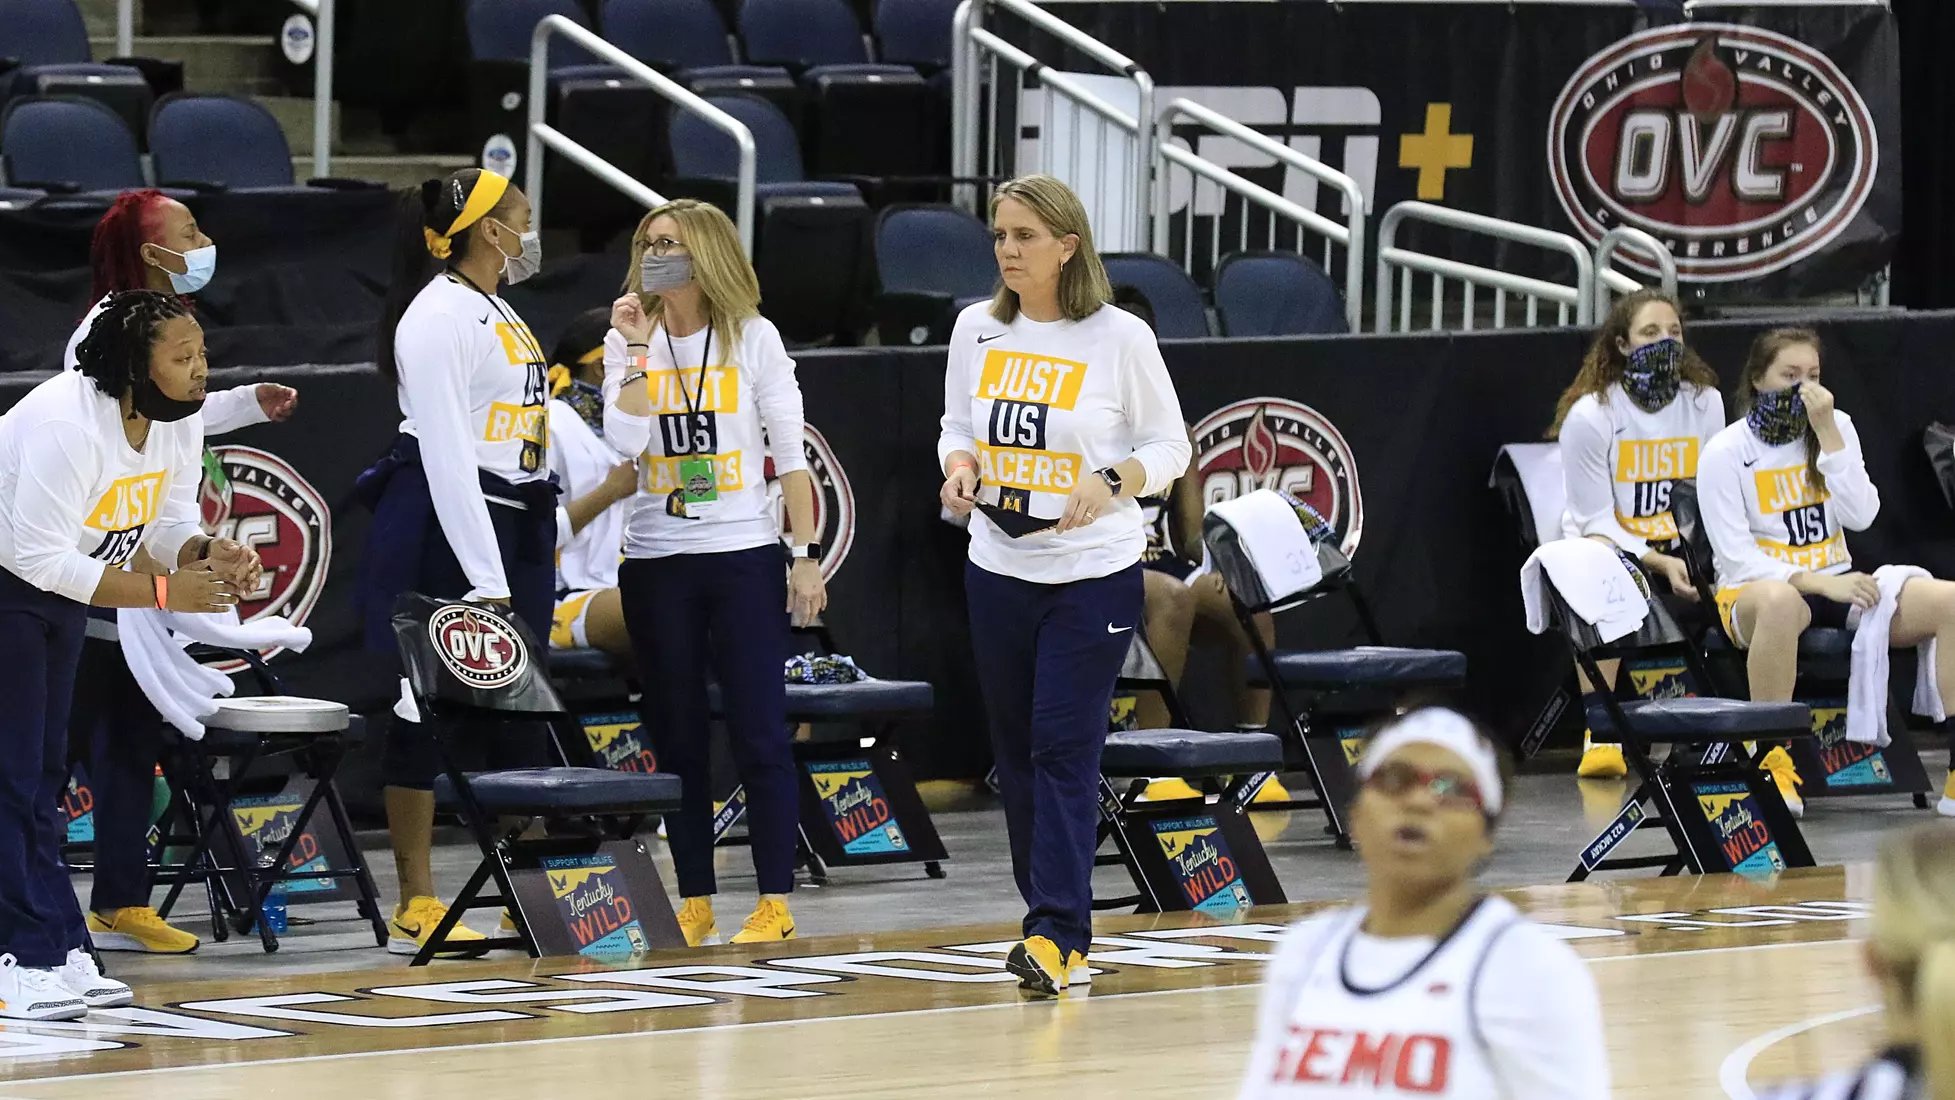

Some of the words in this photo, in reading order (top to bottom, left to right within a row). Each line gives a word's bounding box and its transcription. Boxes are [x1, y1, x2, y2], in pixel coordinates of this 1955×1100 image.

[1582, 52, 1664, 111] OHIO
[1734, 49, 1847, 126] VALLEY
[1616, 111, 1790, 199] OVC
[648, 371, 724, 412] JUST
[987, 356, 1074, 404] JUST
[667, 414, 711, 454] US
[996, 402, 1039, 447] US
[1273, 417, 1346, 478] VALLEY
[1626, 441, 1689, 480] JUST
[977, 451, 1074, 489] ACERS
[100, 477, 159, 528] JUST
[231, 465, 319, 527] VALLEY
[1640, 479, 1673, 517] US
[96, 528, 138, 565] US
[1789, 506, 1824, 547] US
[1286, 547, 1314, 575] 31
[450, 629, 502, 664] OVC
[829, 780, 872, 817] Kentucky
[835, 798, 889, 842] WILD
[1157, 820, 1184, 831] SUPPORT
[1185, 816, 1215, 829] WILDLIFE
[1715, 801, 1753, 839] Kentucky
[548, 857, 579, 868] SUPPORT
[580, 855, 614, 866] WILDLIFE
[1175, 839, 1219, 877] Kentucky
[1722, 819, 1769, 865] WILD
[565, 877, 614, 917] Kentucky
[1183, 856, 1236, 905] WILD
[570, 896, 632, 946] WILD
